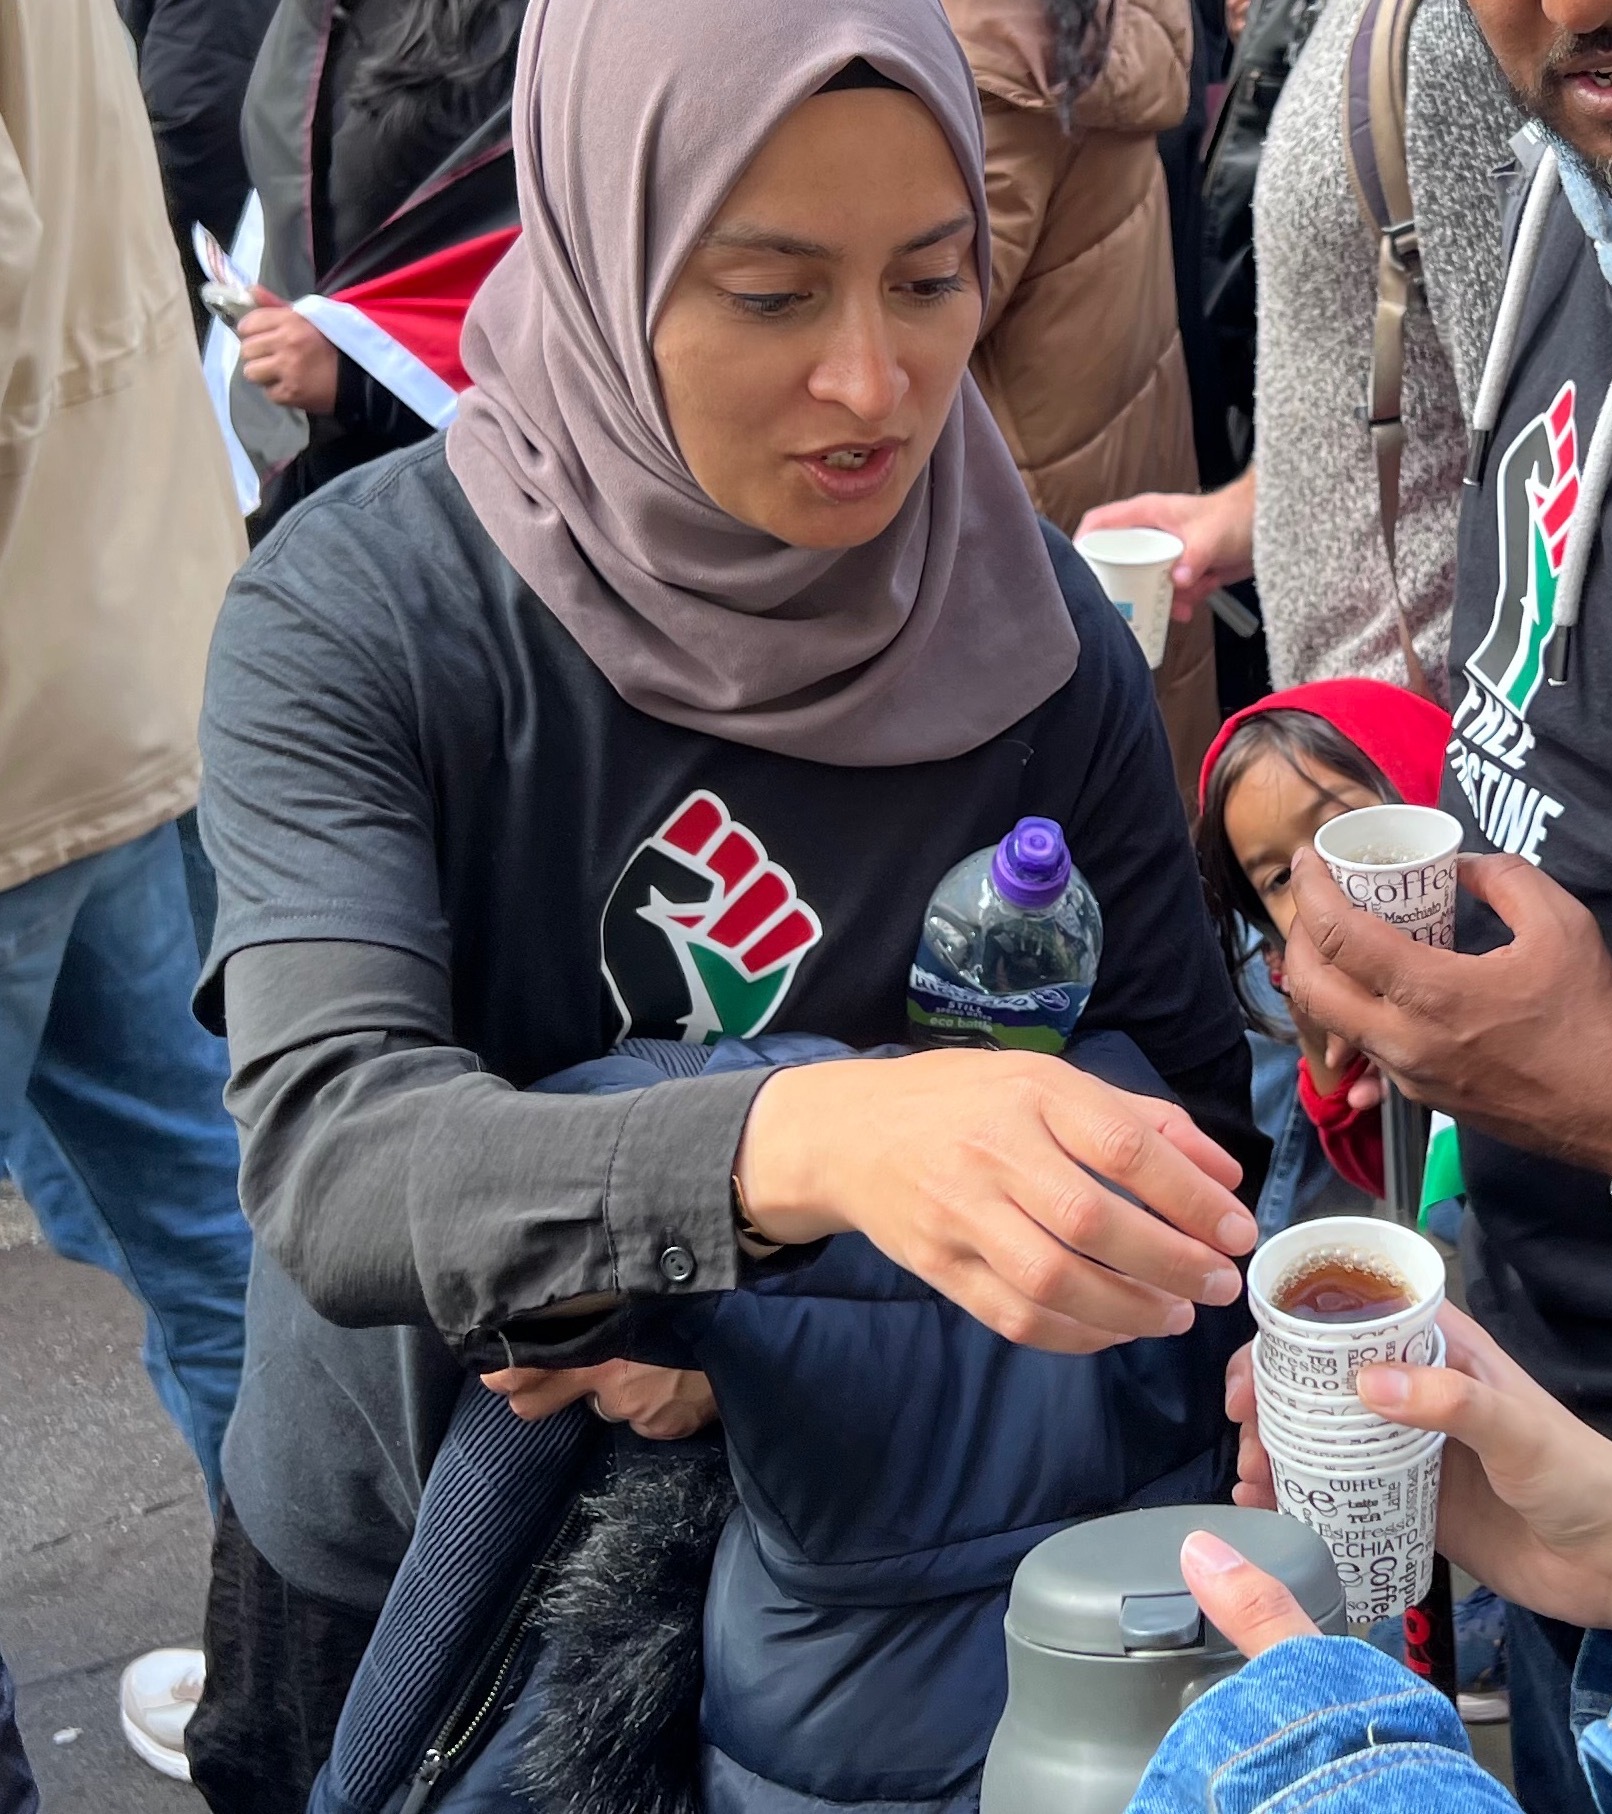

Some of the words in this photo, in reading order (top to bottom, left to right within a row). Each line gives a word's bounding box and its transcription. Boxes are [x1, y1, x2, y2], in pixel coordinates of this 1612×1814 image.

[1445, 738, 1566, 867] STINE
[1346, 859, 1457, 904] Coffee
[1383, 901, 1442, 924] Macchiato
[948, 1000, 983, 1014] STILL
[929, 1016, 954, 1028] eco
[957, 1016, 993, 1034] bottle
[1318, 1515, 1416, 1543] Espresso
[1347, 1512, 1382, 1524] TEA
[1331, 1527, 1418, 1558] CCHIATO
[1399, 1542, 1424, 1607] Cappu
